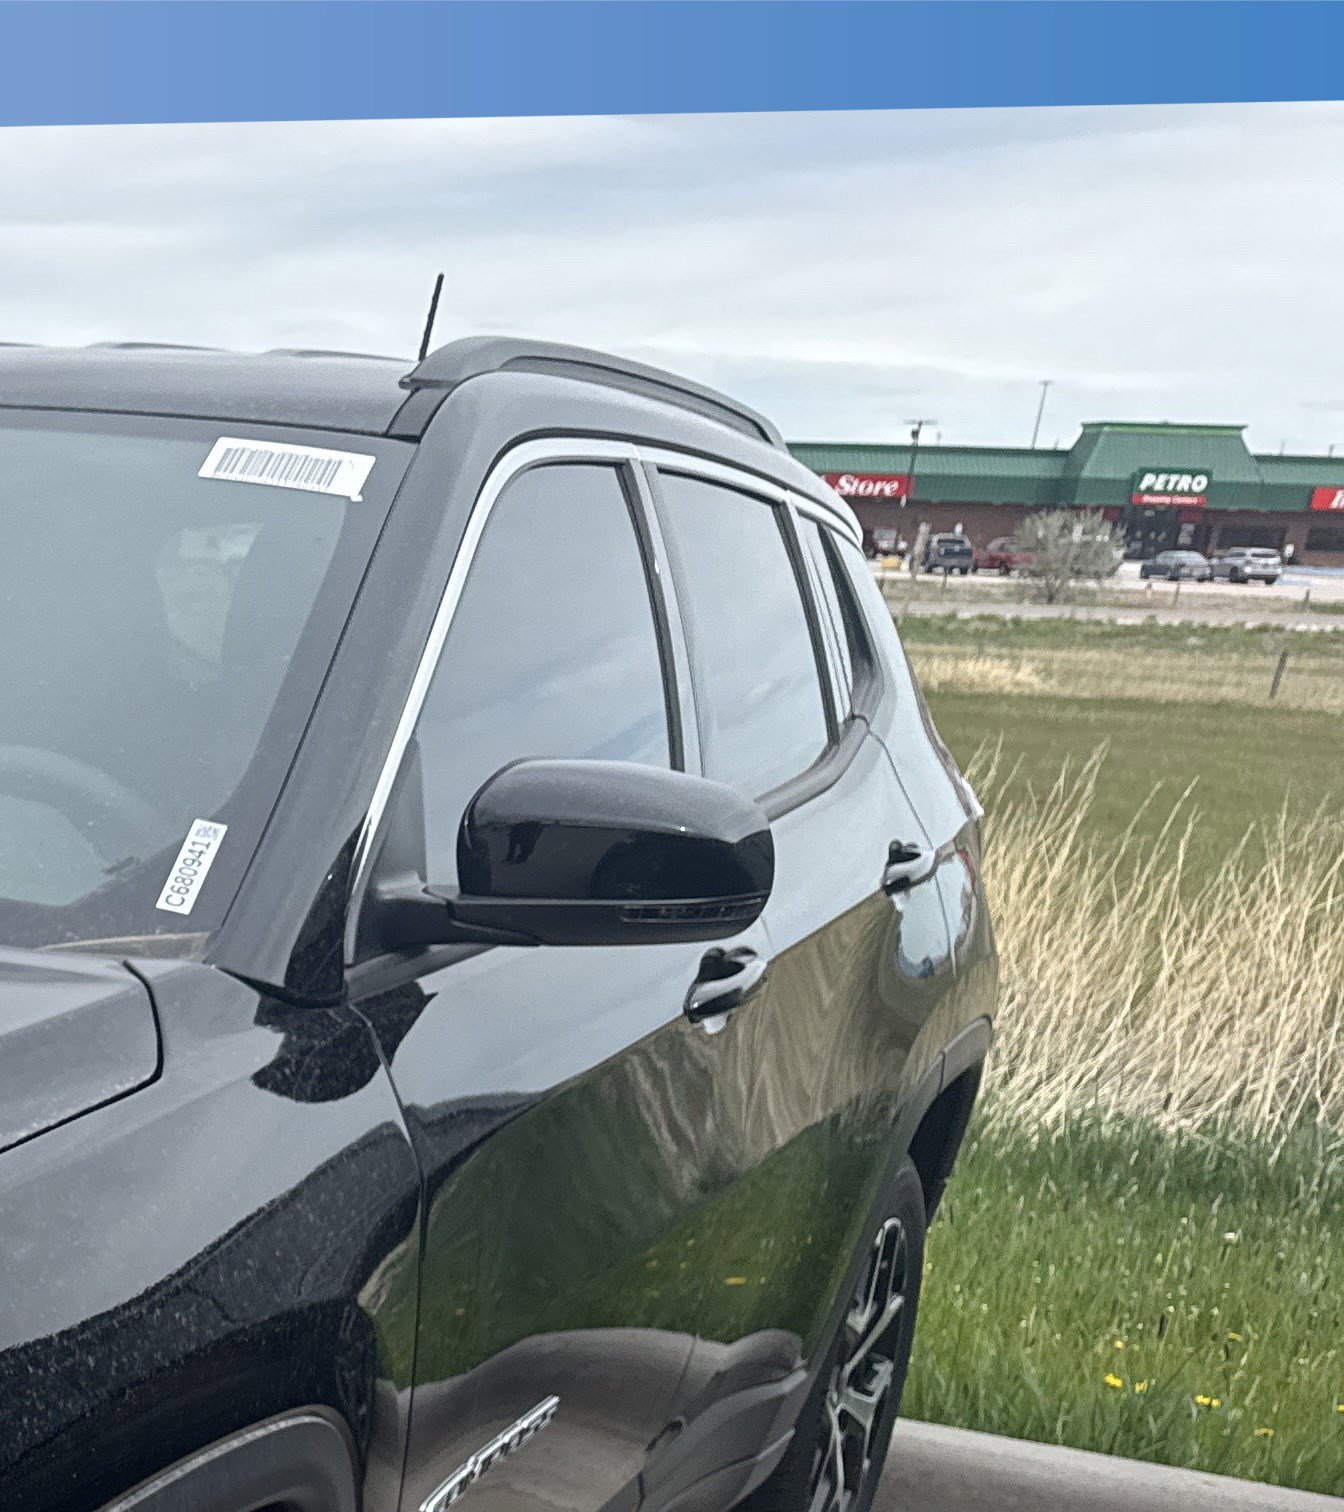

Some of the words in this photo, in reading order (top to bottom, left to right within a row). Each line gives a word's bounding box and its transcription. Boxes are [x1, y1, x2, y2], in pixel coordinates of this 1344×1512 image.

[836, 474, 900, 496] Store
[1139, 473, 1208, 492] PETRO
[165, 840, 211, 907] C680941
